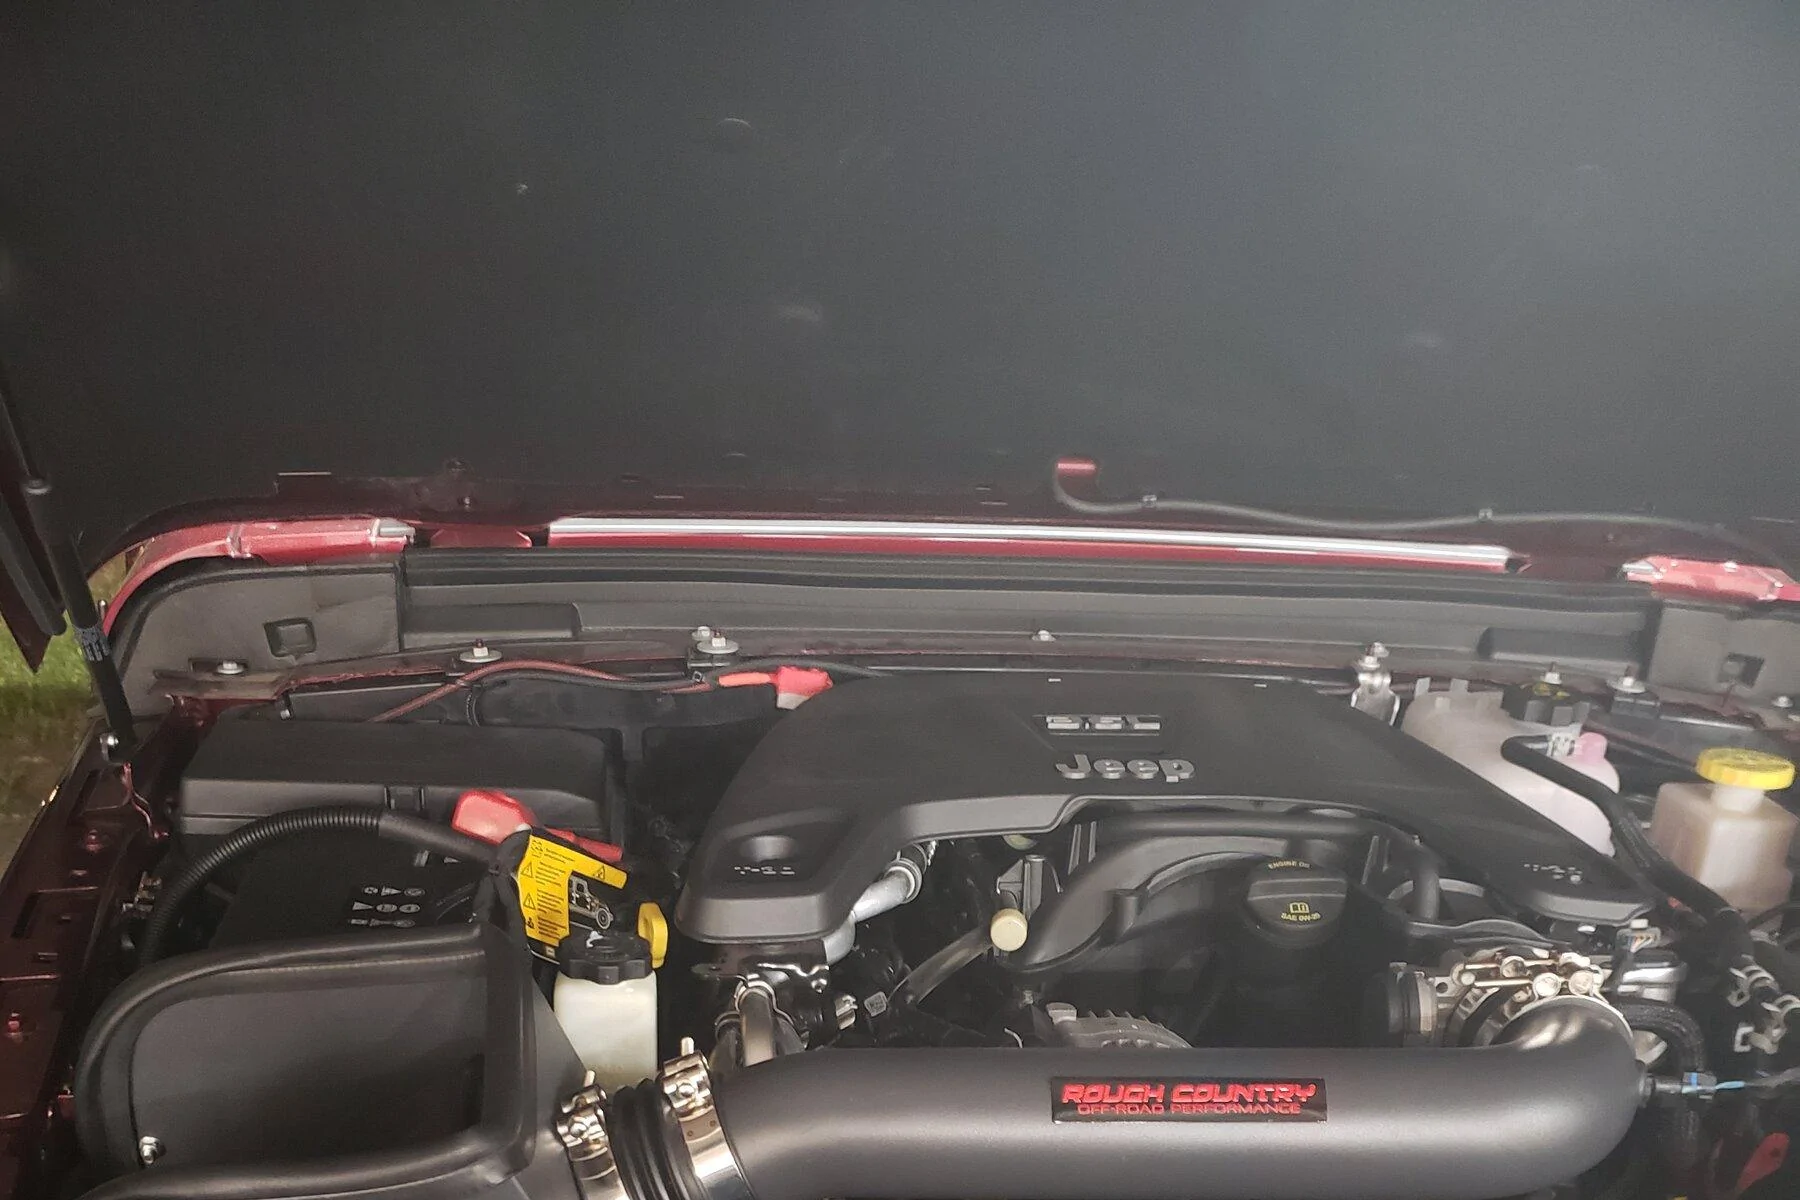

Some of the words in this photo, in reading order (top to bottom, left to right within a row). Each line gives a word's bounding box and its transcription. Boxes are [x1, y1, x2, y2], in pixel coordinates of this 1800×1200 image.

[1055, 754, 1195, 783] Jeep
[1062, 1084, 1165, 1103] ROUGH
[1171, 1083, 1317, 1103] COUNTRY
[1077, 1103, 1165, 1115] OFF-ROAD
[1170, 1102, 1301, 1115] PERFORMANCE
